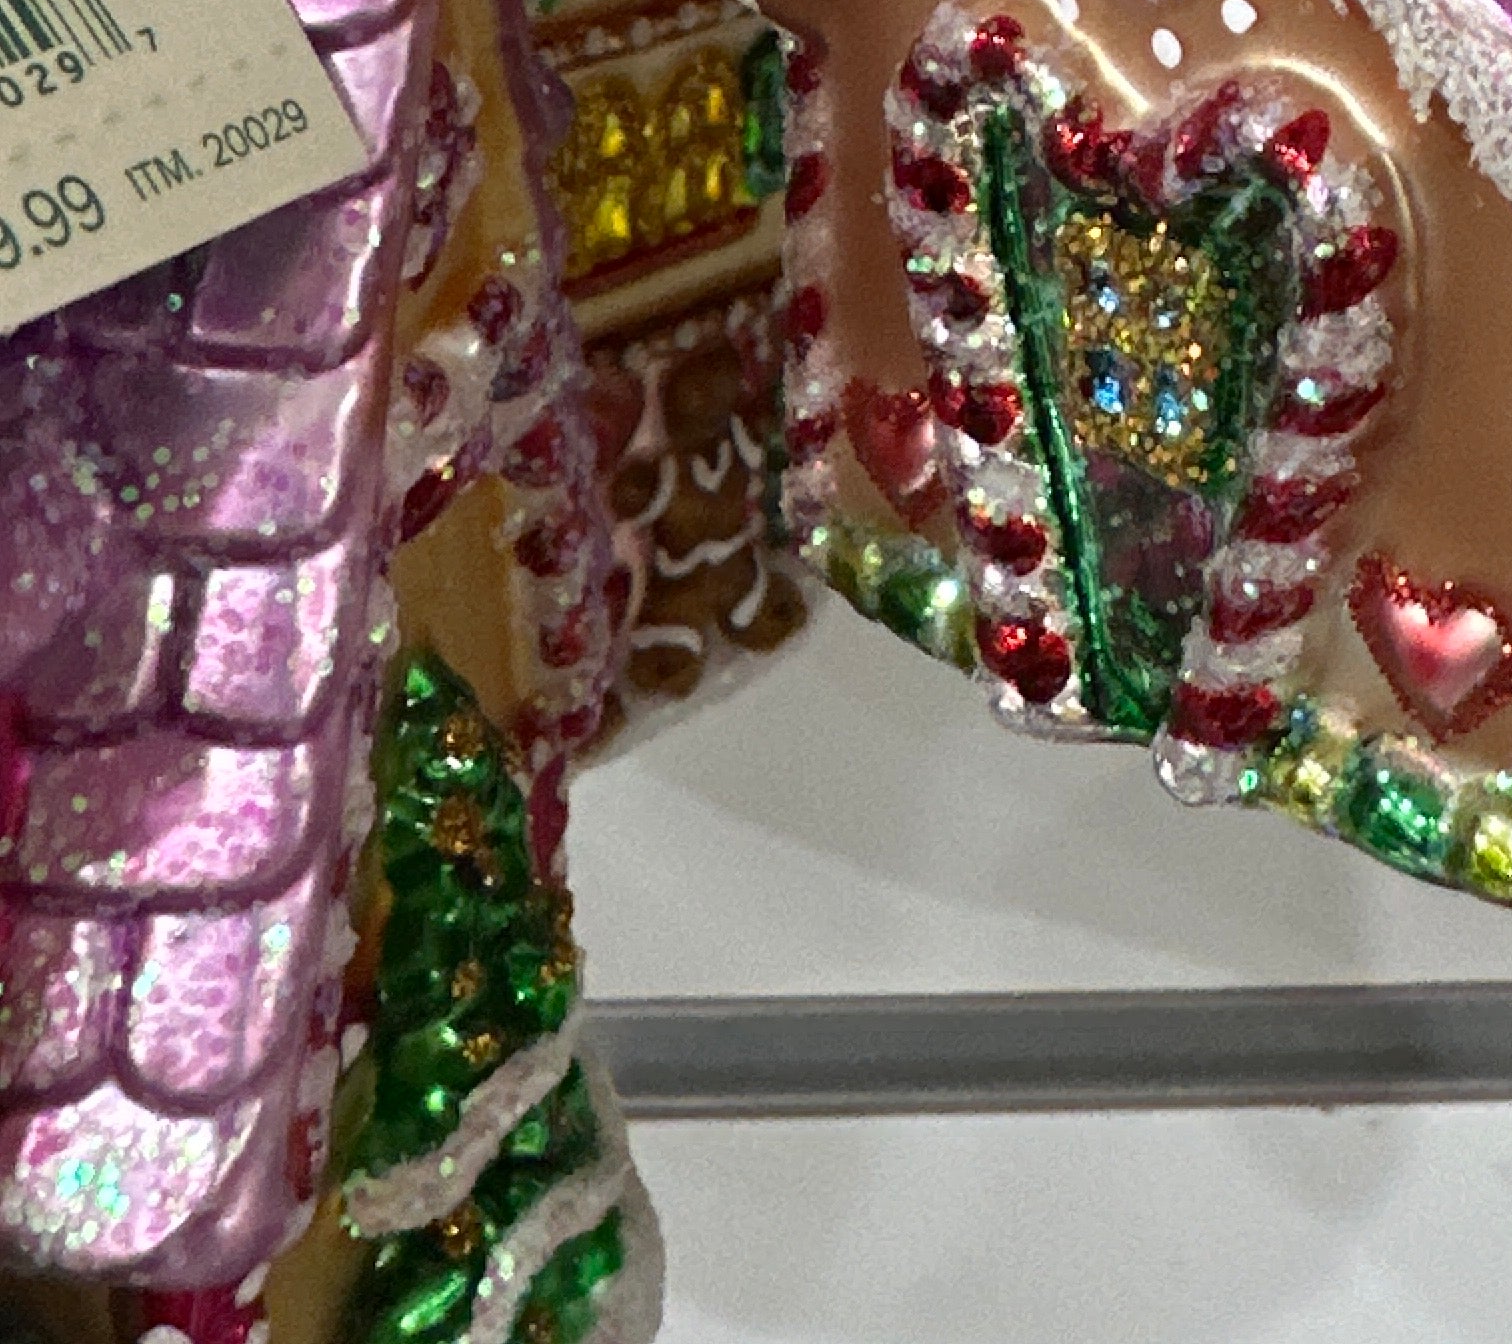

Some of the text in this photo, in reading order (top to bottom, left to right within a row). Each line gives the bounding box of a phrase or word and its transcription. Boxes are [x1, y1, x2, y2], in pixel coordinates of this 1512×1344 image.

[134, 26, 158, 53] 7
[124, 148, 204, 202] ITM.
[202, 97, 309, 168] 20029
